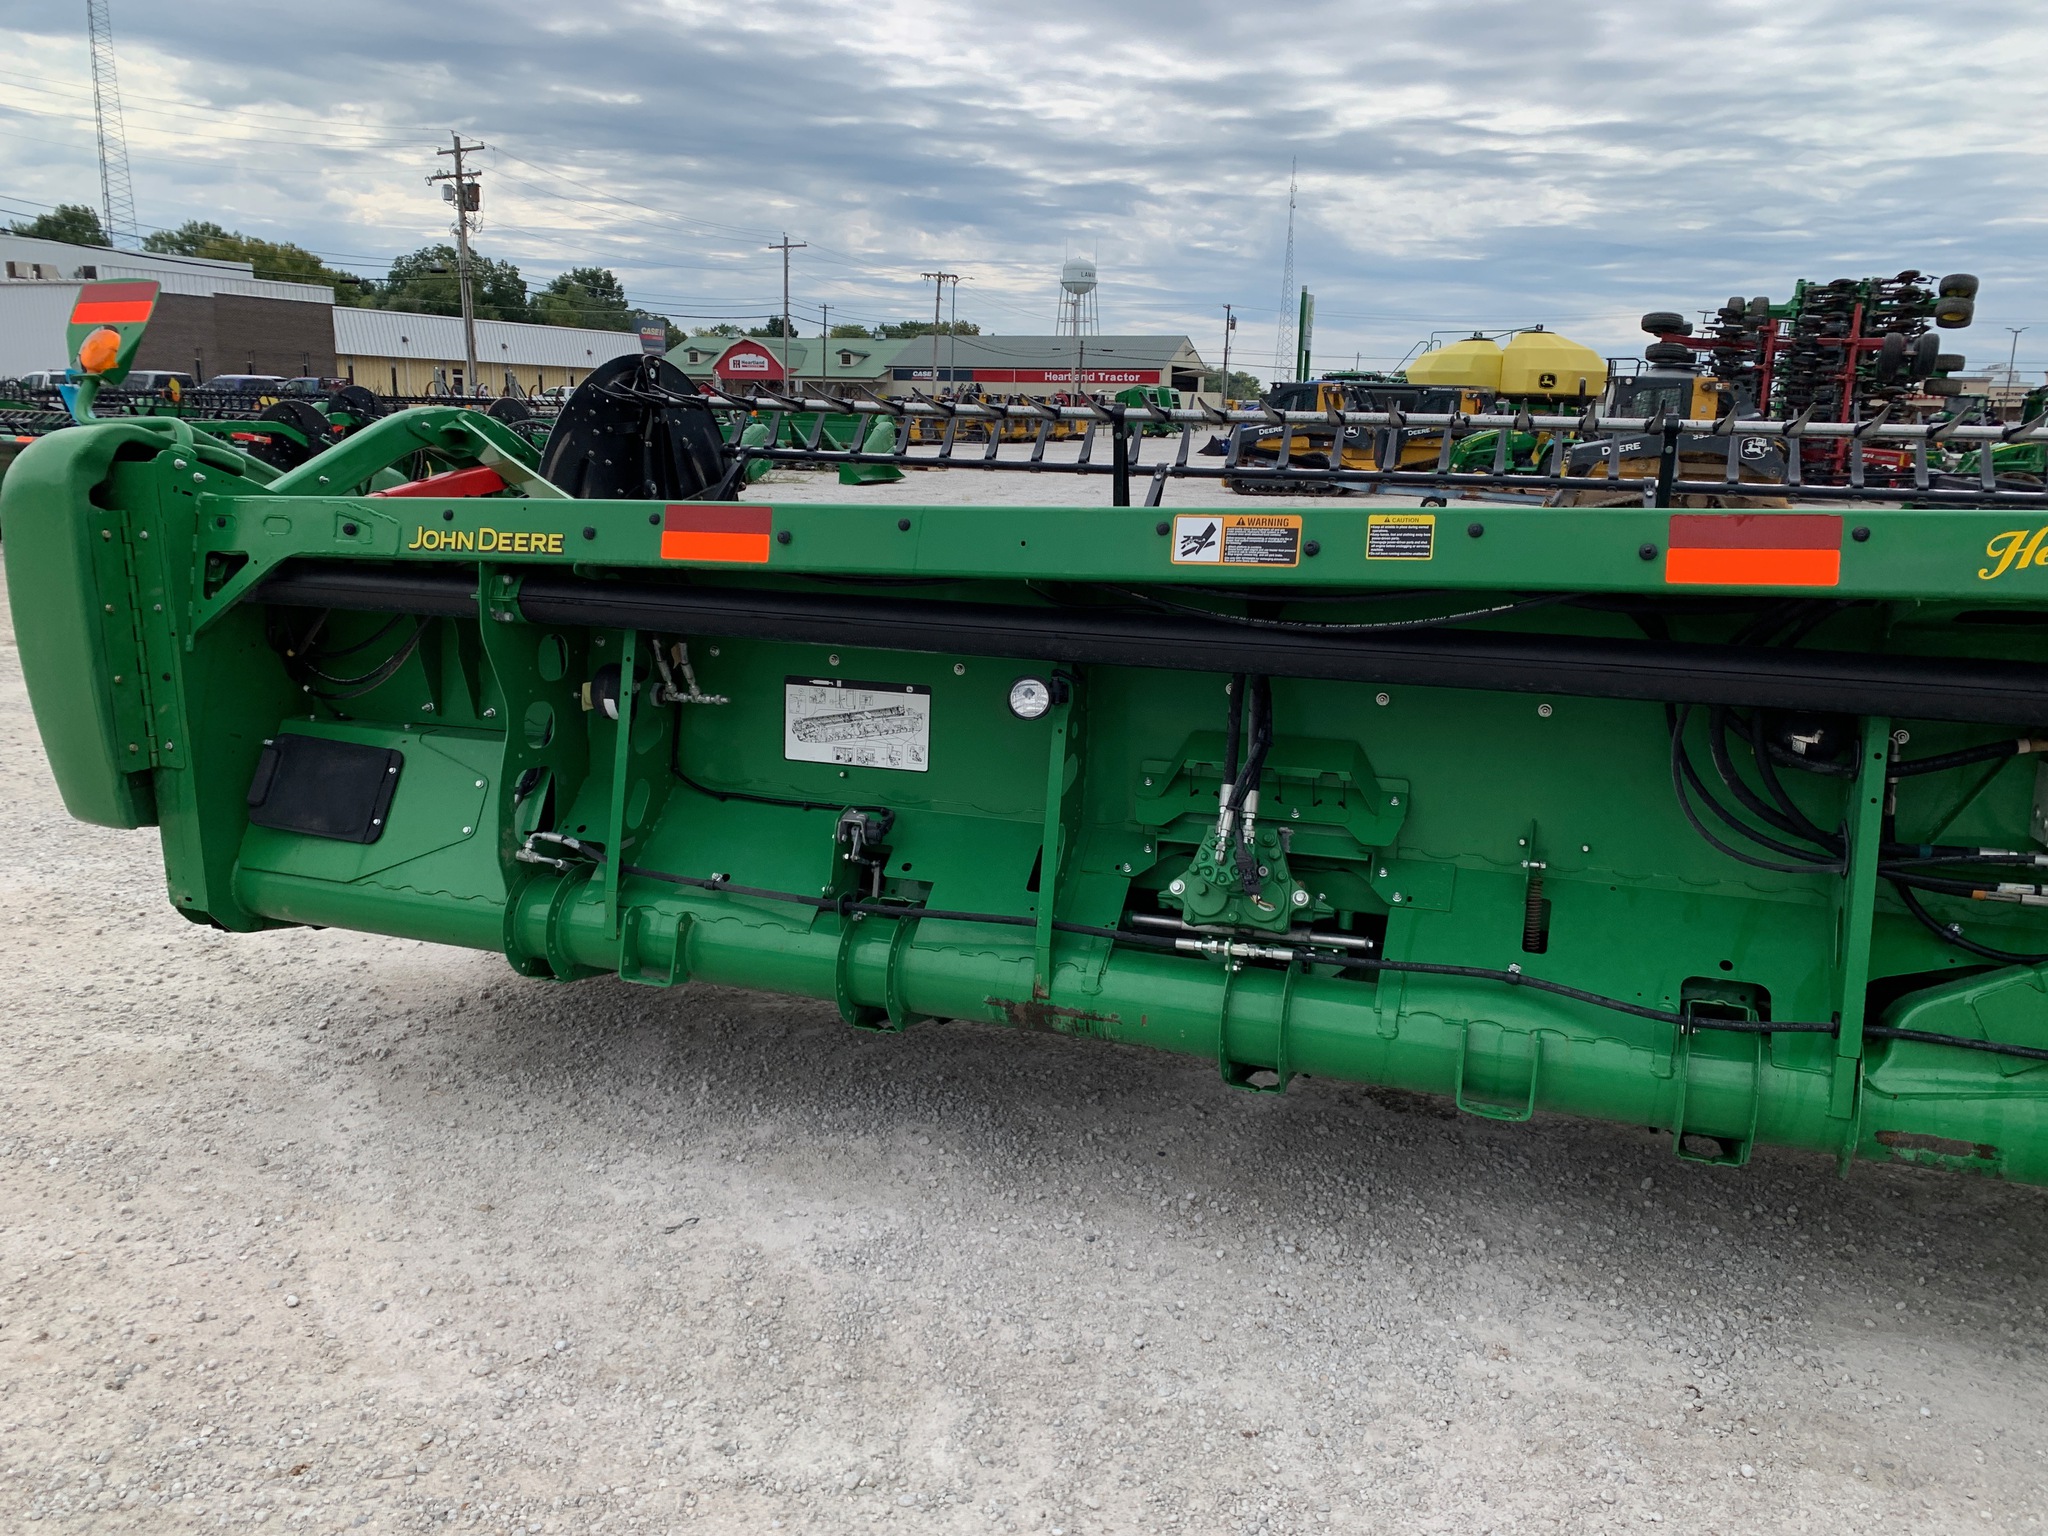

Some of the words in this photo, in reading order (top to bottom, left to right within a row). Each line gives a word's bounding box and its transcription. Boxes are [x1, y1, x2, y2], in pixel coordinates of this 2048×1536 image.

[641, 327, 659, 335] CASE
[1044, 371, 1095, 381] Heartand
[1098, 372, 1140, 381] Tractor
[1258, 426, 1284, 436] DEERE
[1601, 442, 1642, 456] DERE
[1247, 518, 1290, 527] WARNING
[408, 525, 475, 551] JOHN
[477, 527, 565, 554] DEERE
